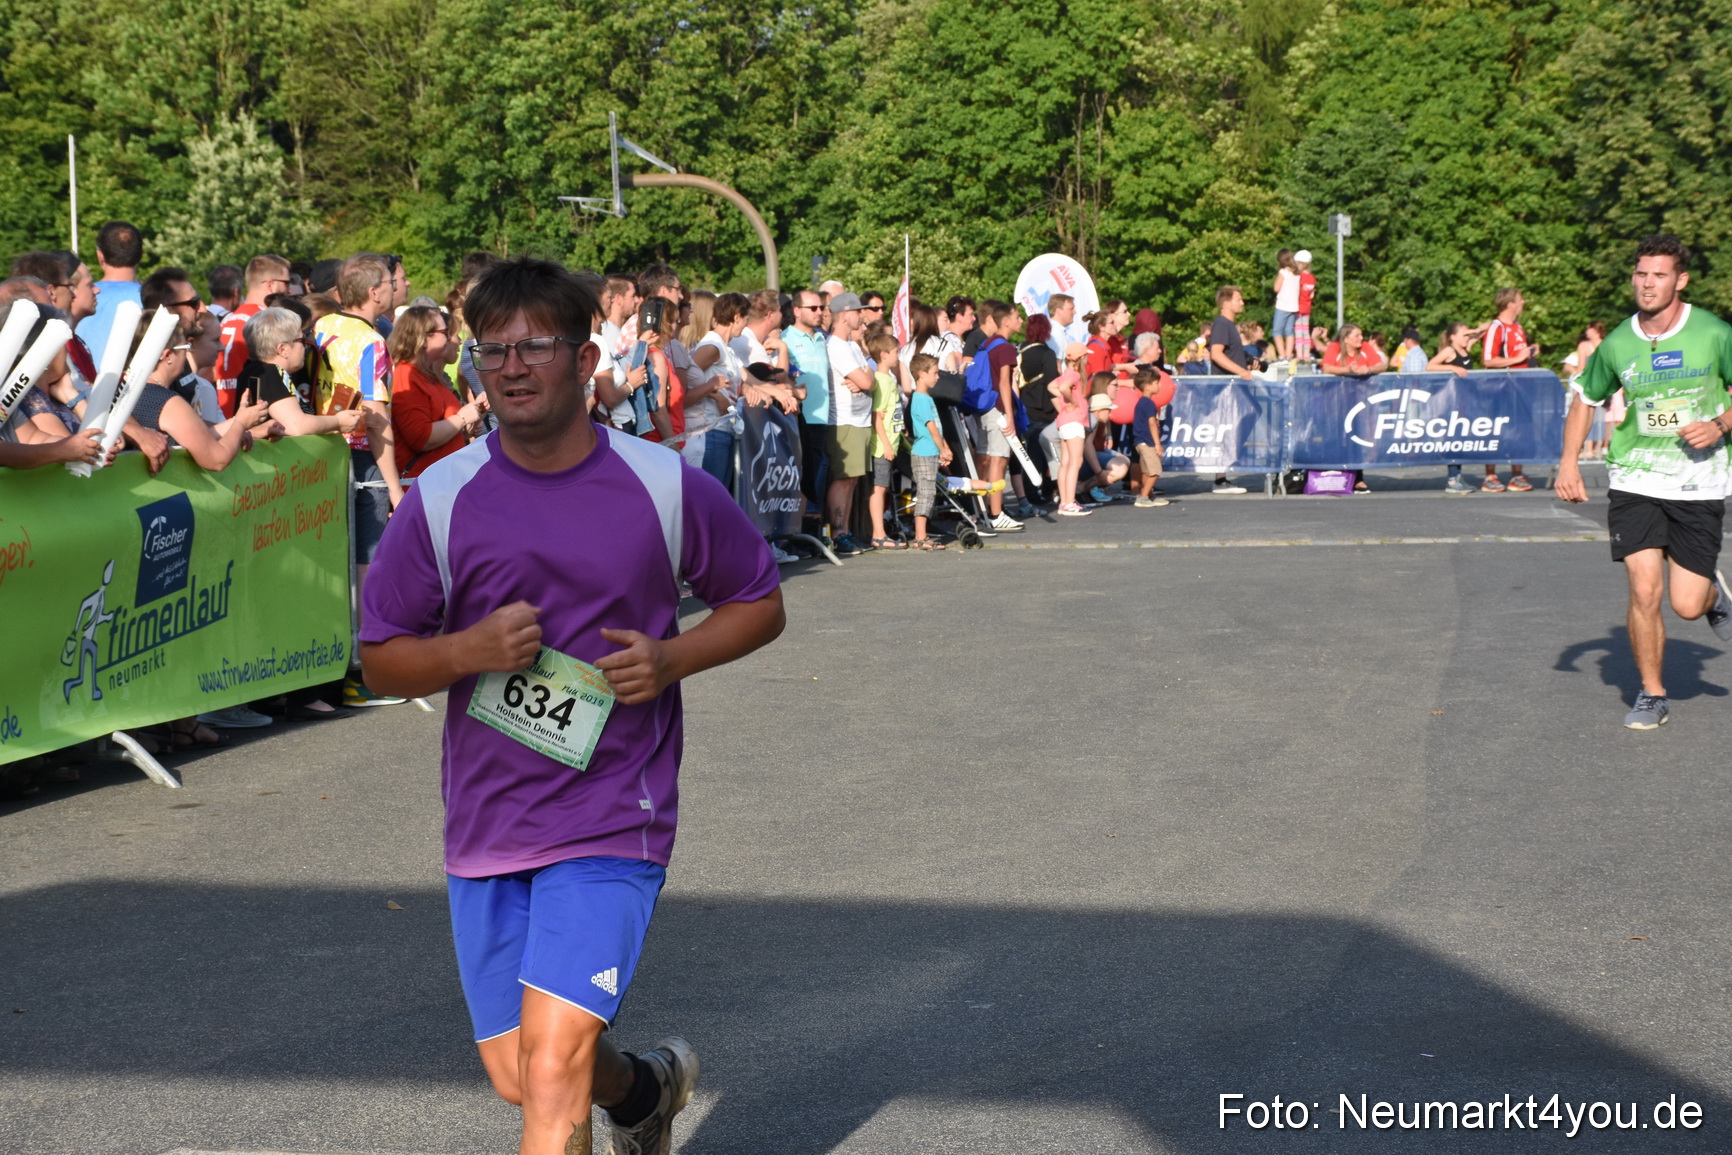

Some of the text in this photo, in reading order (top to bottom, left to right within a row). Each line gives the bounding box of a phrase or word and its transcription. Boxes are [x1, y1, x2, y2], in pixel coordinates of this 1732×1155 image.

[221, 326, 237, 372] 7
[1637, 362, 1713, 385] firmenlauf
[1374, 411, 1510, 440] Fischer
[1647, 412, 1680, 427] 564
[1386, 440, 1500, 454] AUTOMOBILE
[232, 459, 329, 518] Gesunde Firmen
[253, 485, 341, 553] laufen länger!
[151, 528, 188, 554] Fischer
[109, 559, 235, 666] firmenlauf
[109, 648, 166, 691] neumarkt
[197, 634, 345, 694] www.firmenlauf-oberpfalz.de
[503, 673, 578, 732] 634
[580, 692, 606, 708] 2019
[496, 703, 533, 729] Holstein
[533, 722, 568, 745] Dennis
